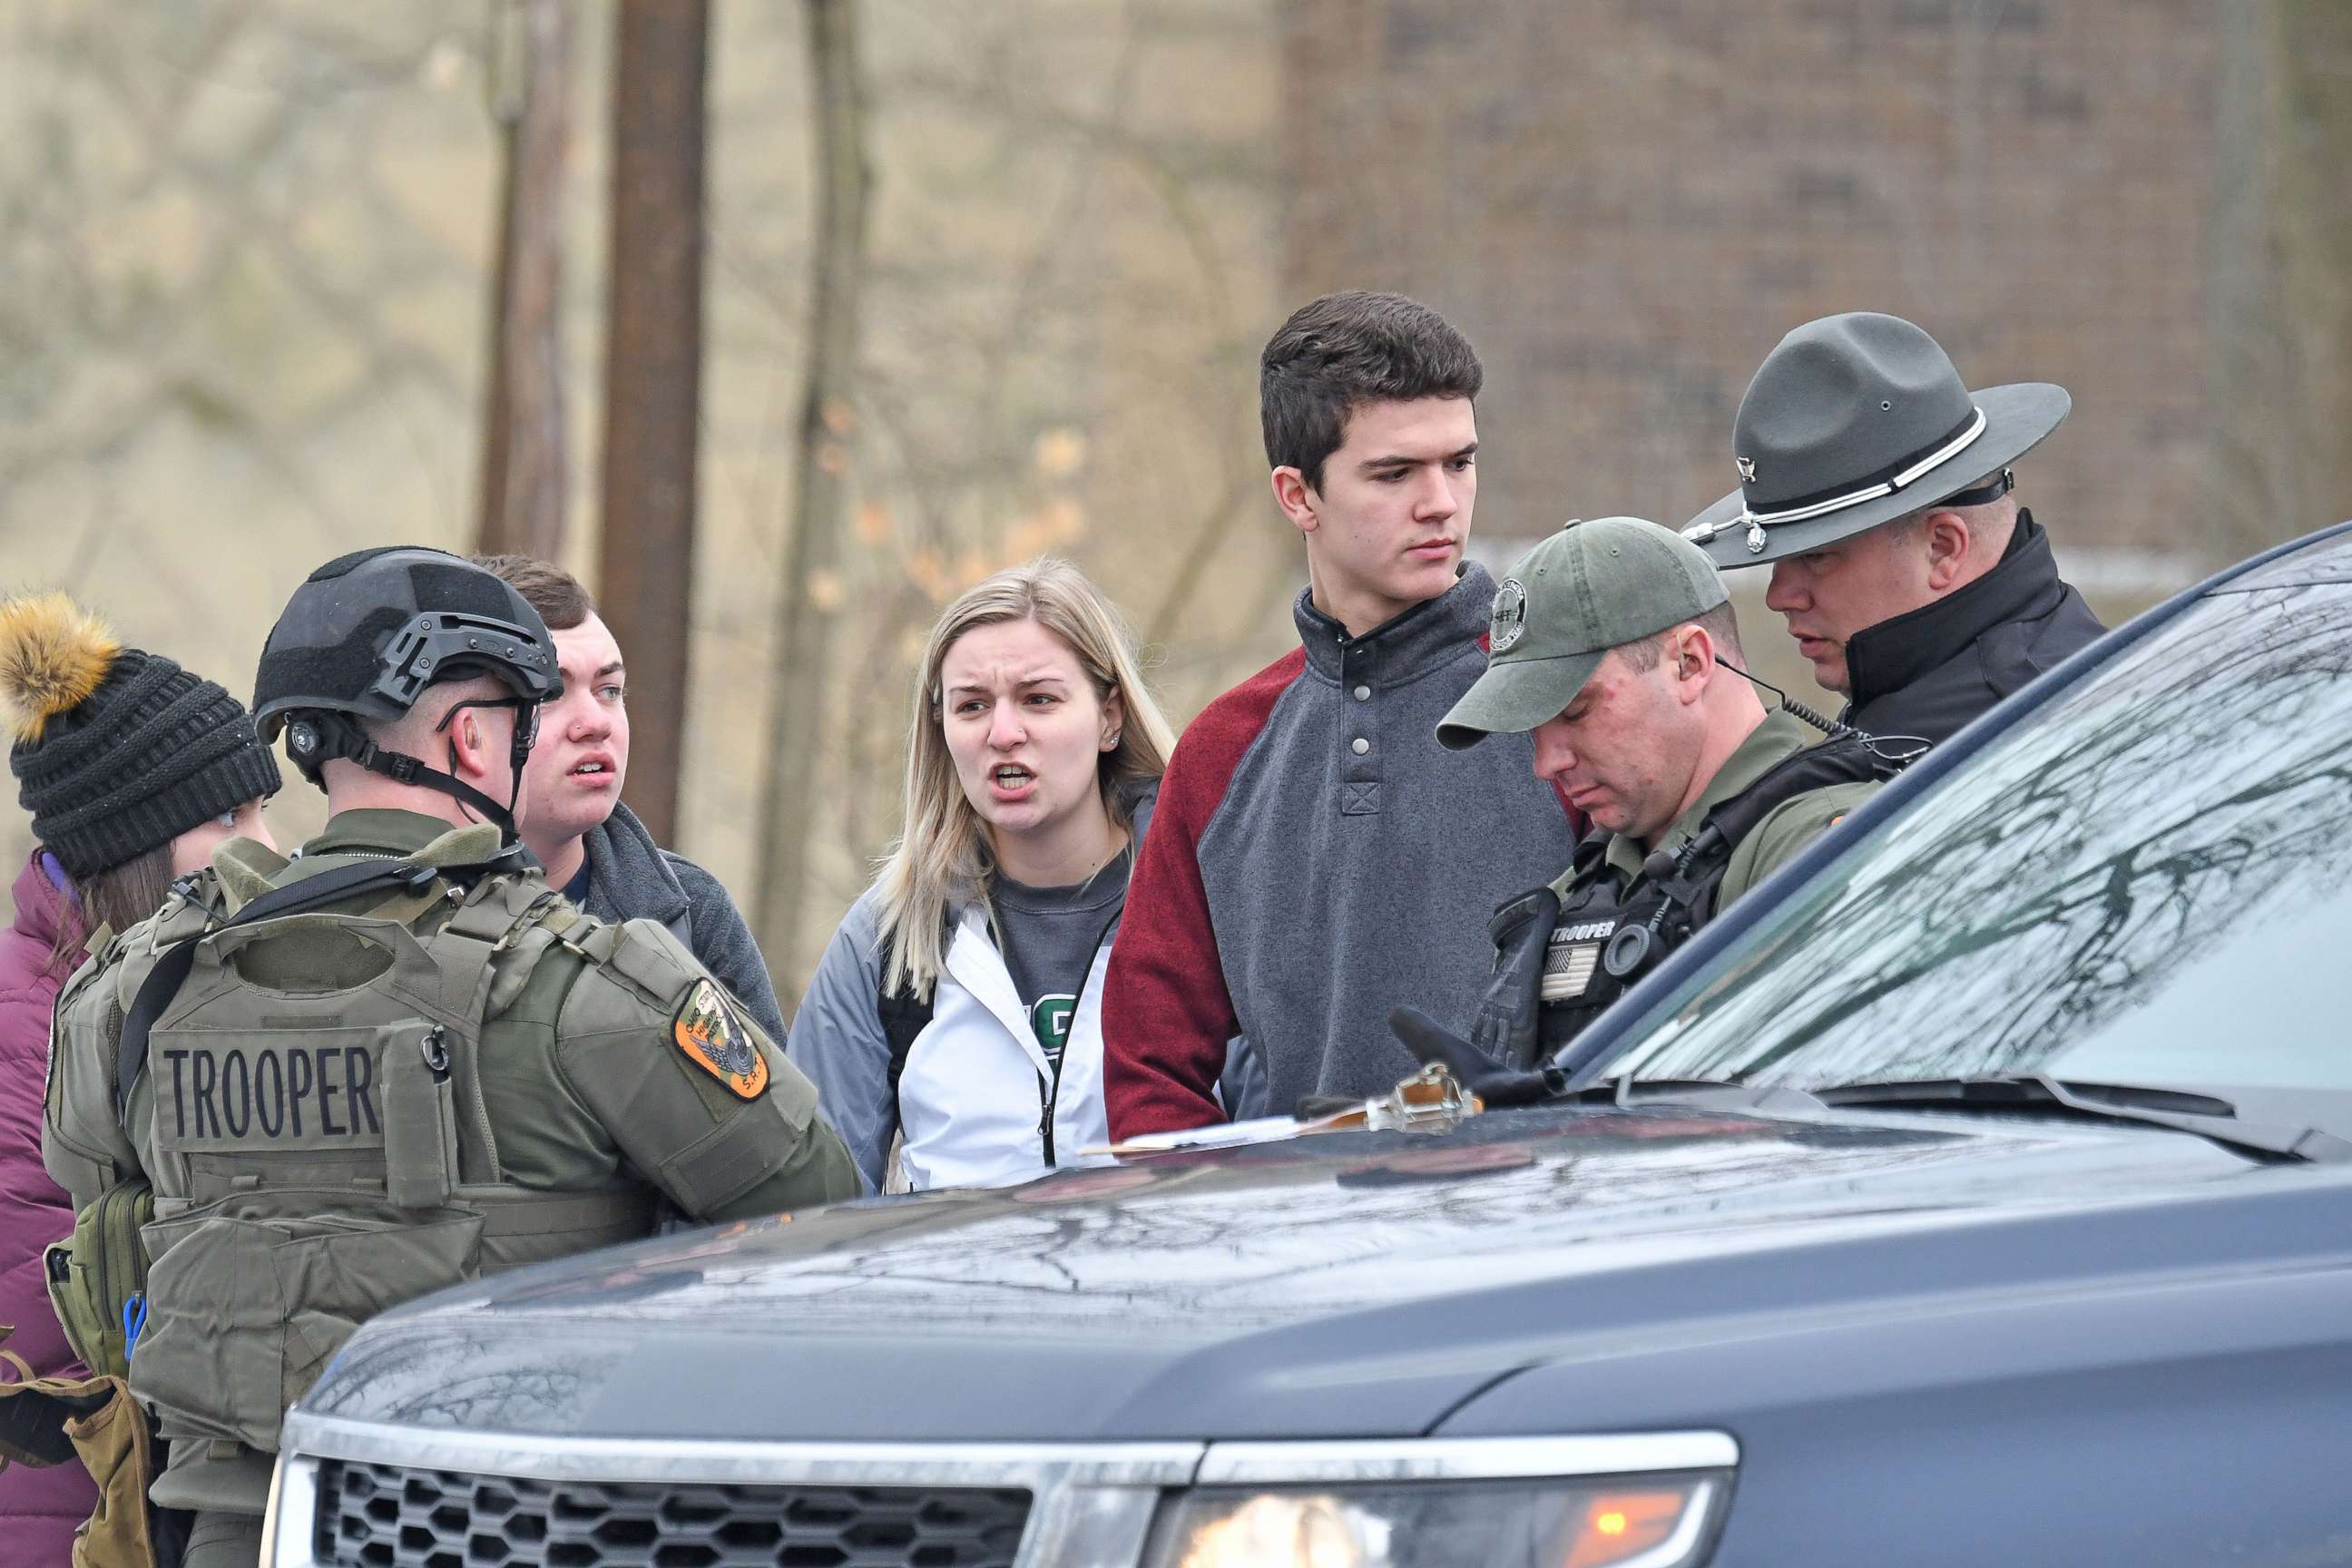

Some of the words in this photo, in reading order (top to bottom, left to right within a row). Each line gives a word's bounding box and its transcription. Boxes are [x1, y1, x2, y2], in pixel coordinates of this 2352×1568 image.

[1550, 921, 1615, 943] TROOPER
[686, 1007, 701, 1033] OHIO
[163, 1047, 380, 1138] TROOPER
